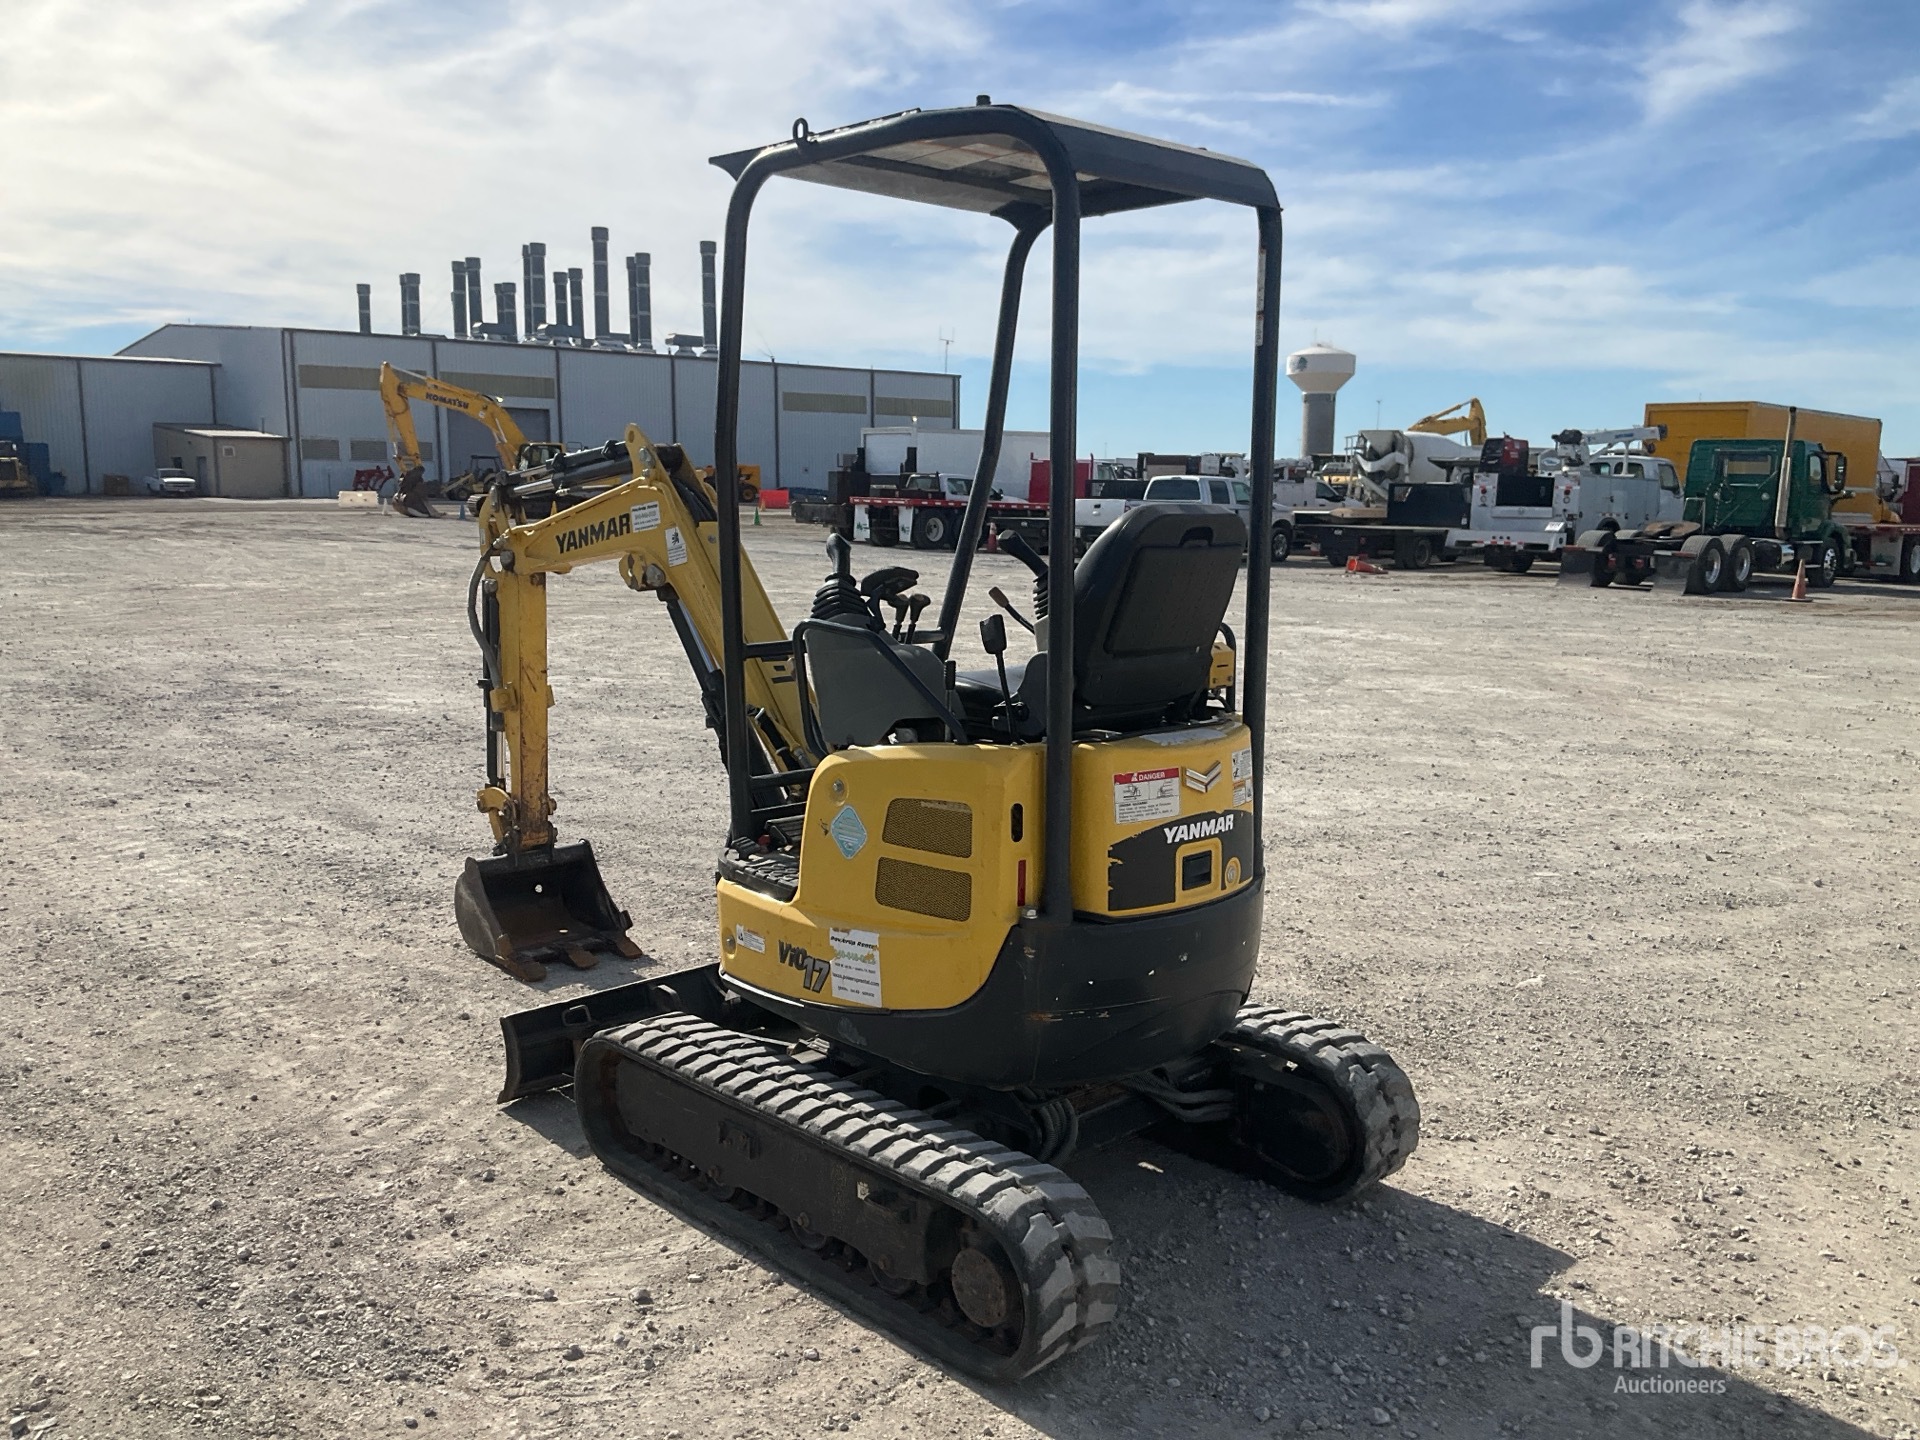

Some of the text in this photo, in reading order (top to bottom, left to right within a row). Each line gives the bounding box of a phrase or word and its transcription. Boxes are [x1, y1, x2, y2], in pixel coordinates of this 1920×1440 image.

[425, 391, 469, 410] KOMATSU
[555, 512, 631, 554] YANMAR
[1138, 771, 1166, 782] DANGER
[1163, 814, 1234, 844] YANMAR
